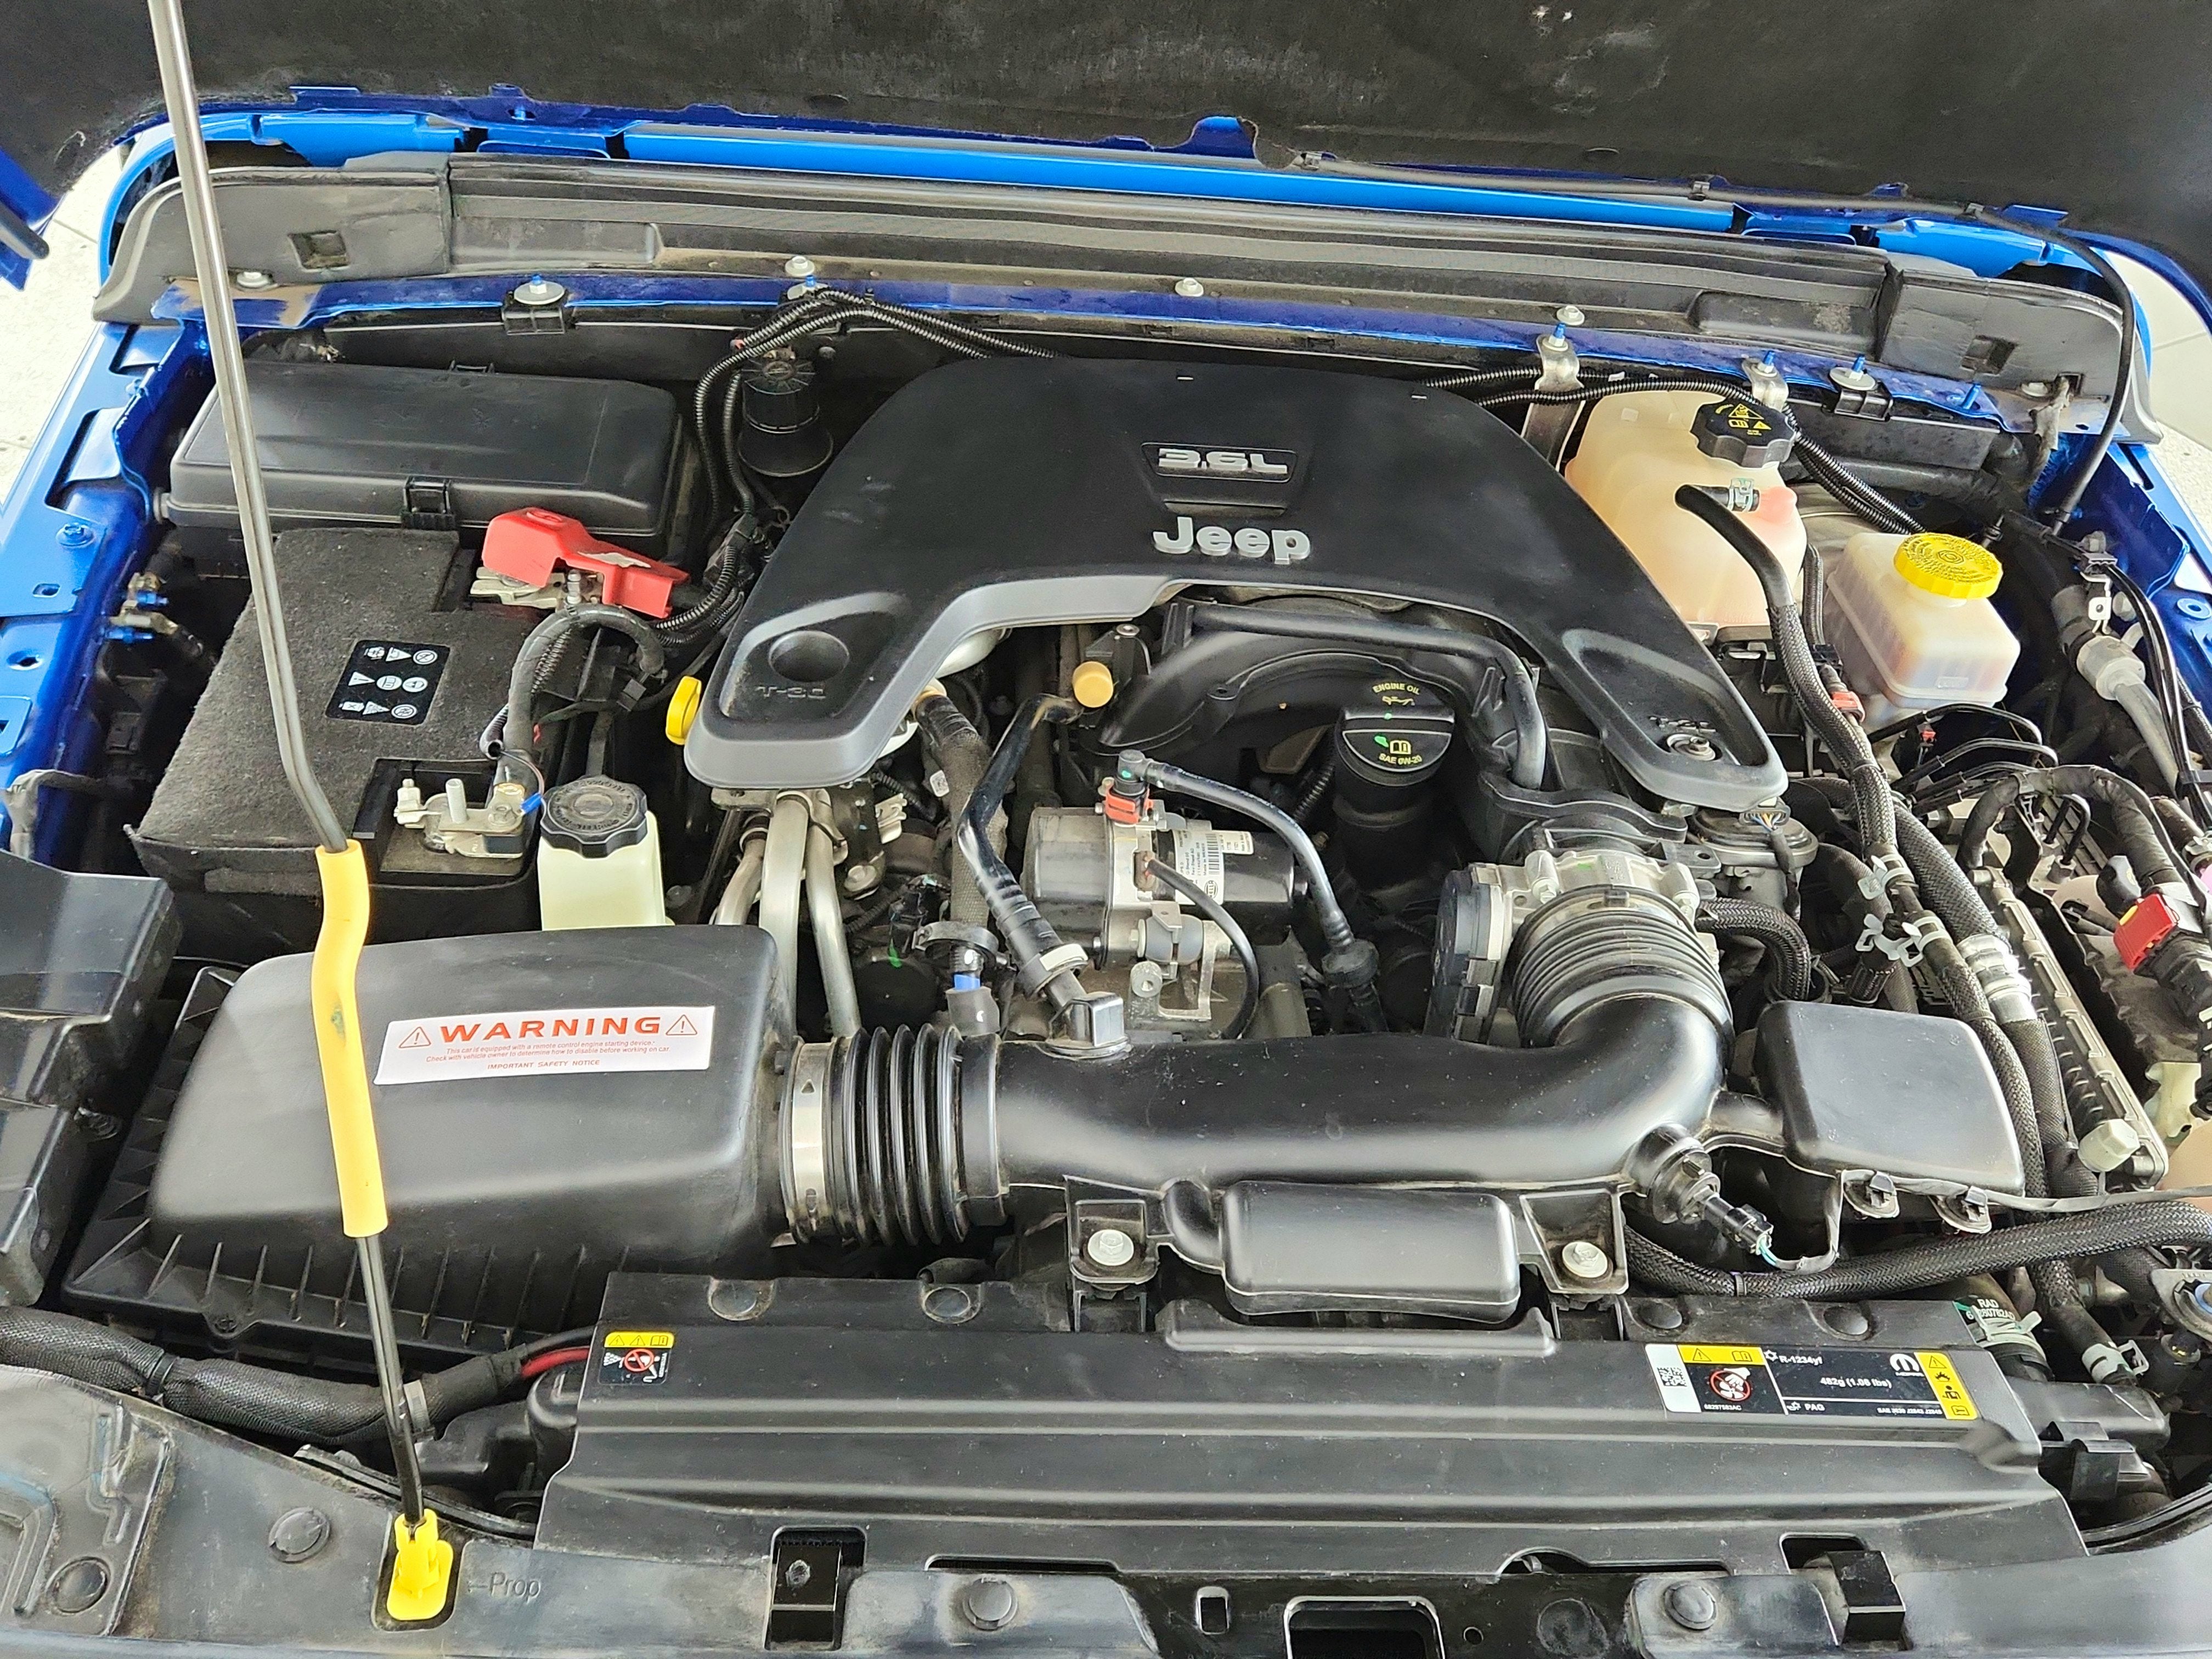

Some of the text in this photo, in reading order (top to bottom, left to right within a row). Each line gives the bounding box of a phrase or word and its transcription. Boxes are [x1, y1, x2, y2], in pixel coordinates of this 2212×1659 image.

[1158, 448, 1288, 474] 3.6L
[1153, 516, 1311, 565] Jeep
[1372, 682, 1420, 695] ENGINE OIL
[1379, 753, 1423, 765] SAE 0W-20
[439, 1016, 661, 1043] WARNING
[1977, 1299, 1999, 1308] RAD
[1820, 1377, 1846, 1387] 482g
[1871, 1378, 1892, 1389] lbs)
[1804, 1403, 1826, 1411] PAG
[489, 1571, 542, 1605] Prop
